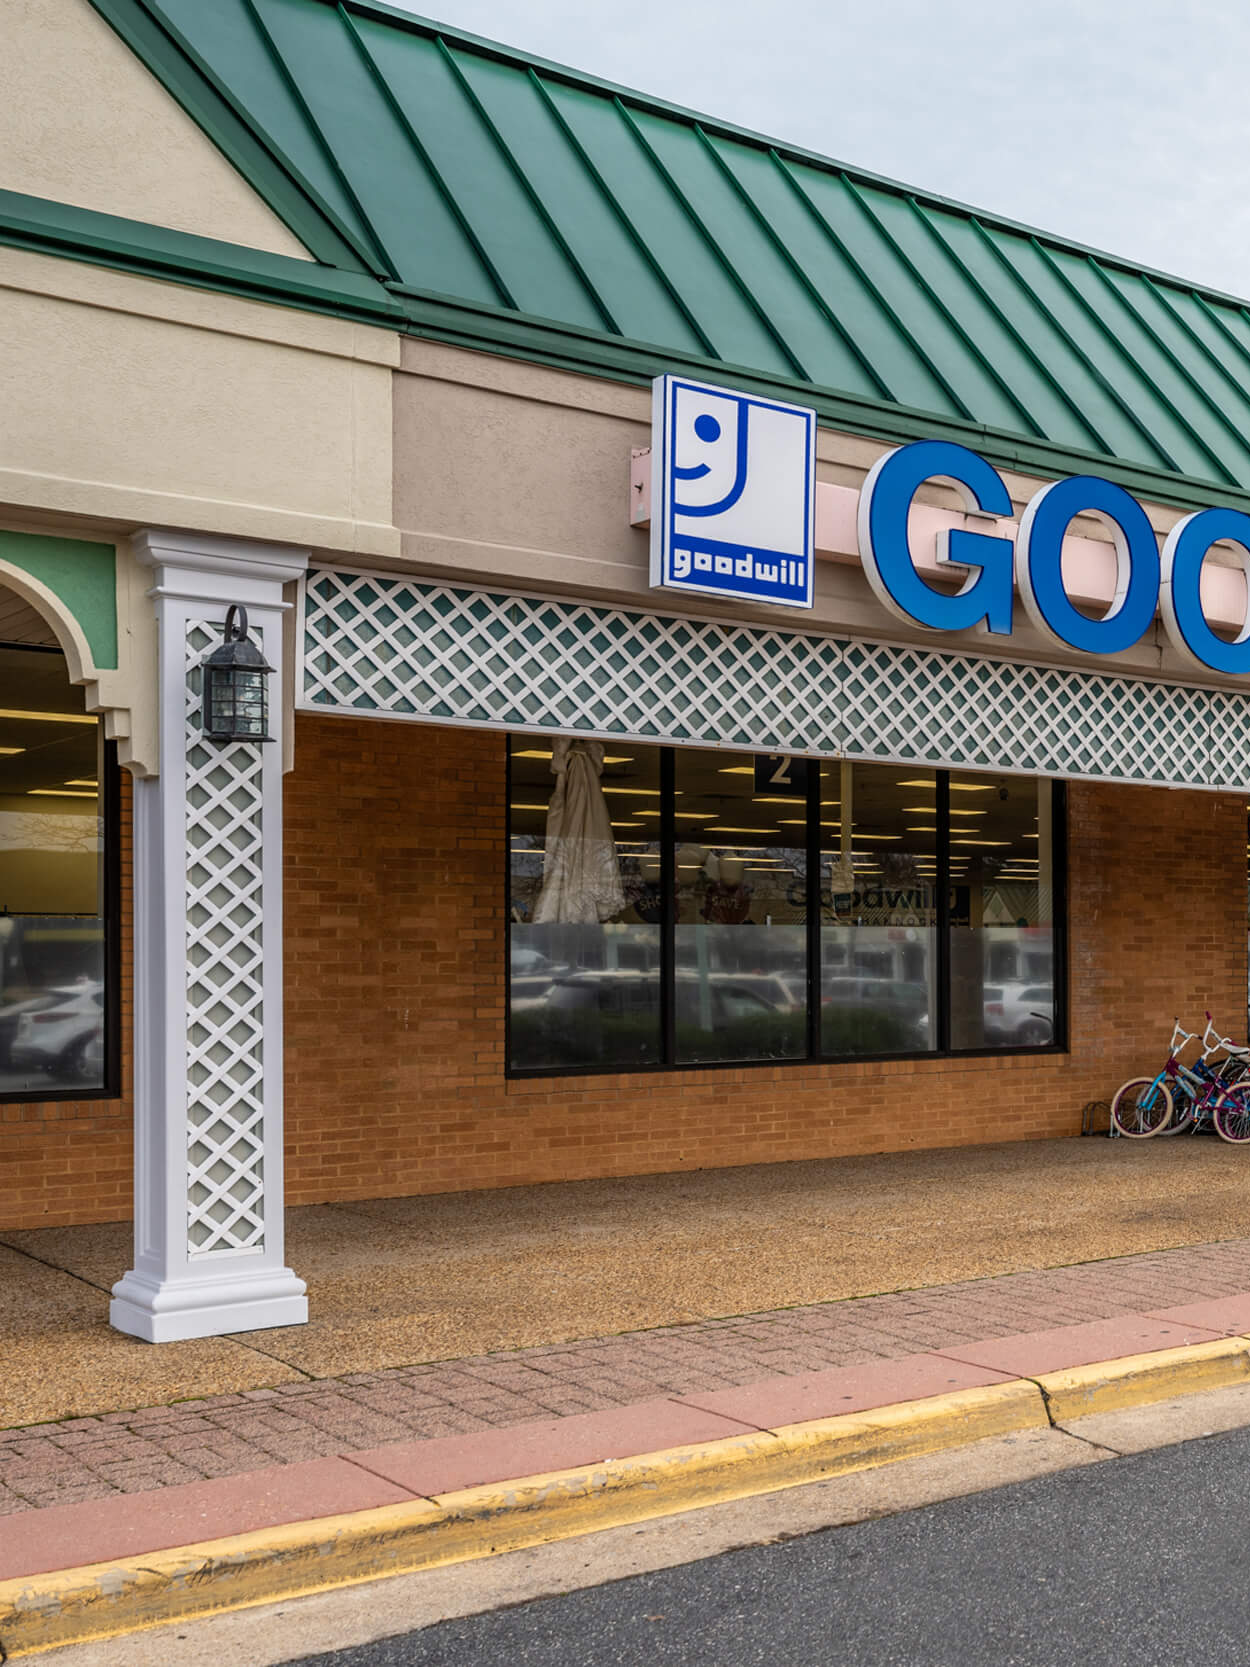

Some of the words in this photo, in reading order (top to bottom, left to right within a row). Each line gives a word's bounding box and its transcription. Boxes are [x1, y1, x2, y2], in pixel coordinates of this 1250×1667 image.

[673, 548, 804, 587] goodwill
[639, 895, 661, 912] SHO
[786, 880, 937, 909] Godwill
